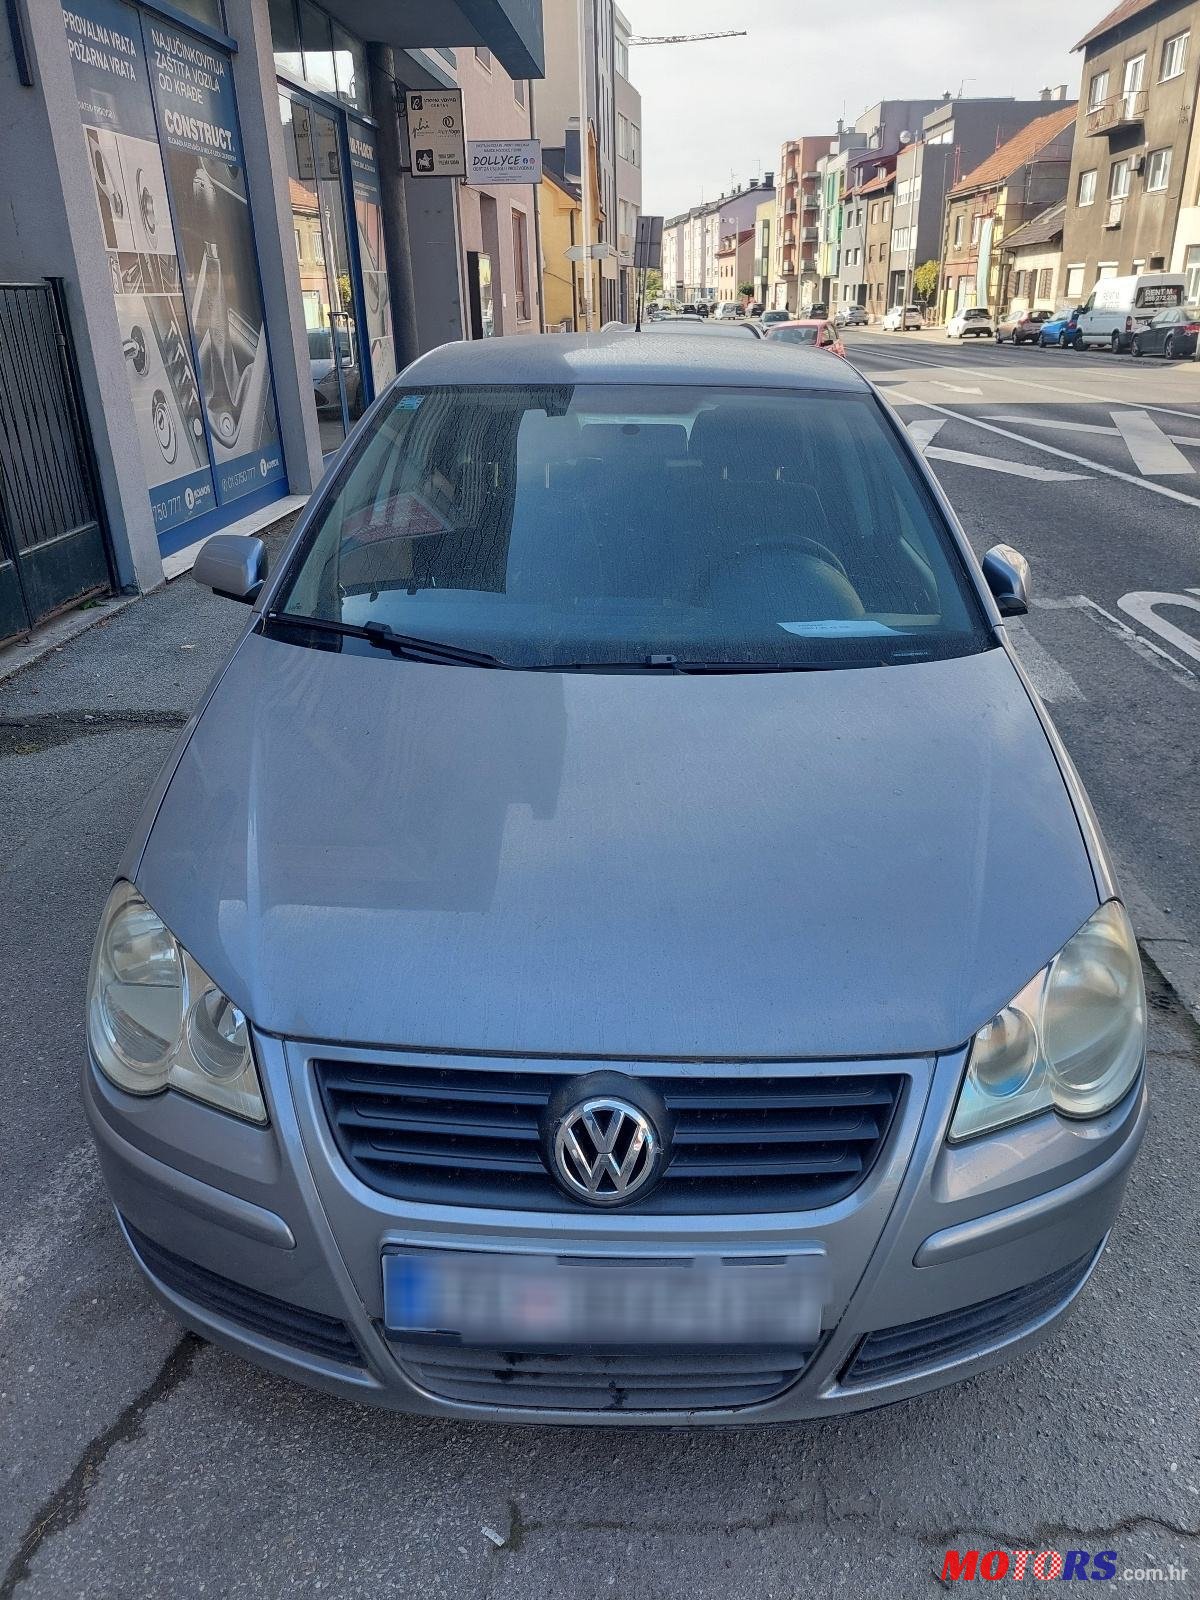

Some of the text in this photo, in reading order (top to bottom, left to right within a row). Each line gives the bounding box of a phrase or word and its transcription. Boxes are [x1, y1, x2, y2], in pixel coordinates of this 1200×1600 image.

[62, 9, 137, 58] PROVALNA VRATA
[151, 28, 225, 77] NAJUČINKOVITIJA
[67, 37, 137, 82] POŽARNA VRATA
[155, 50, 221, 93] ZAŠTITA VOZILA
[158, 72, 173, 93] OD
[472, 155, 521, 167] DOLLYCE
[1145, 288, 1166, 297] RENT
